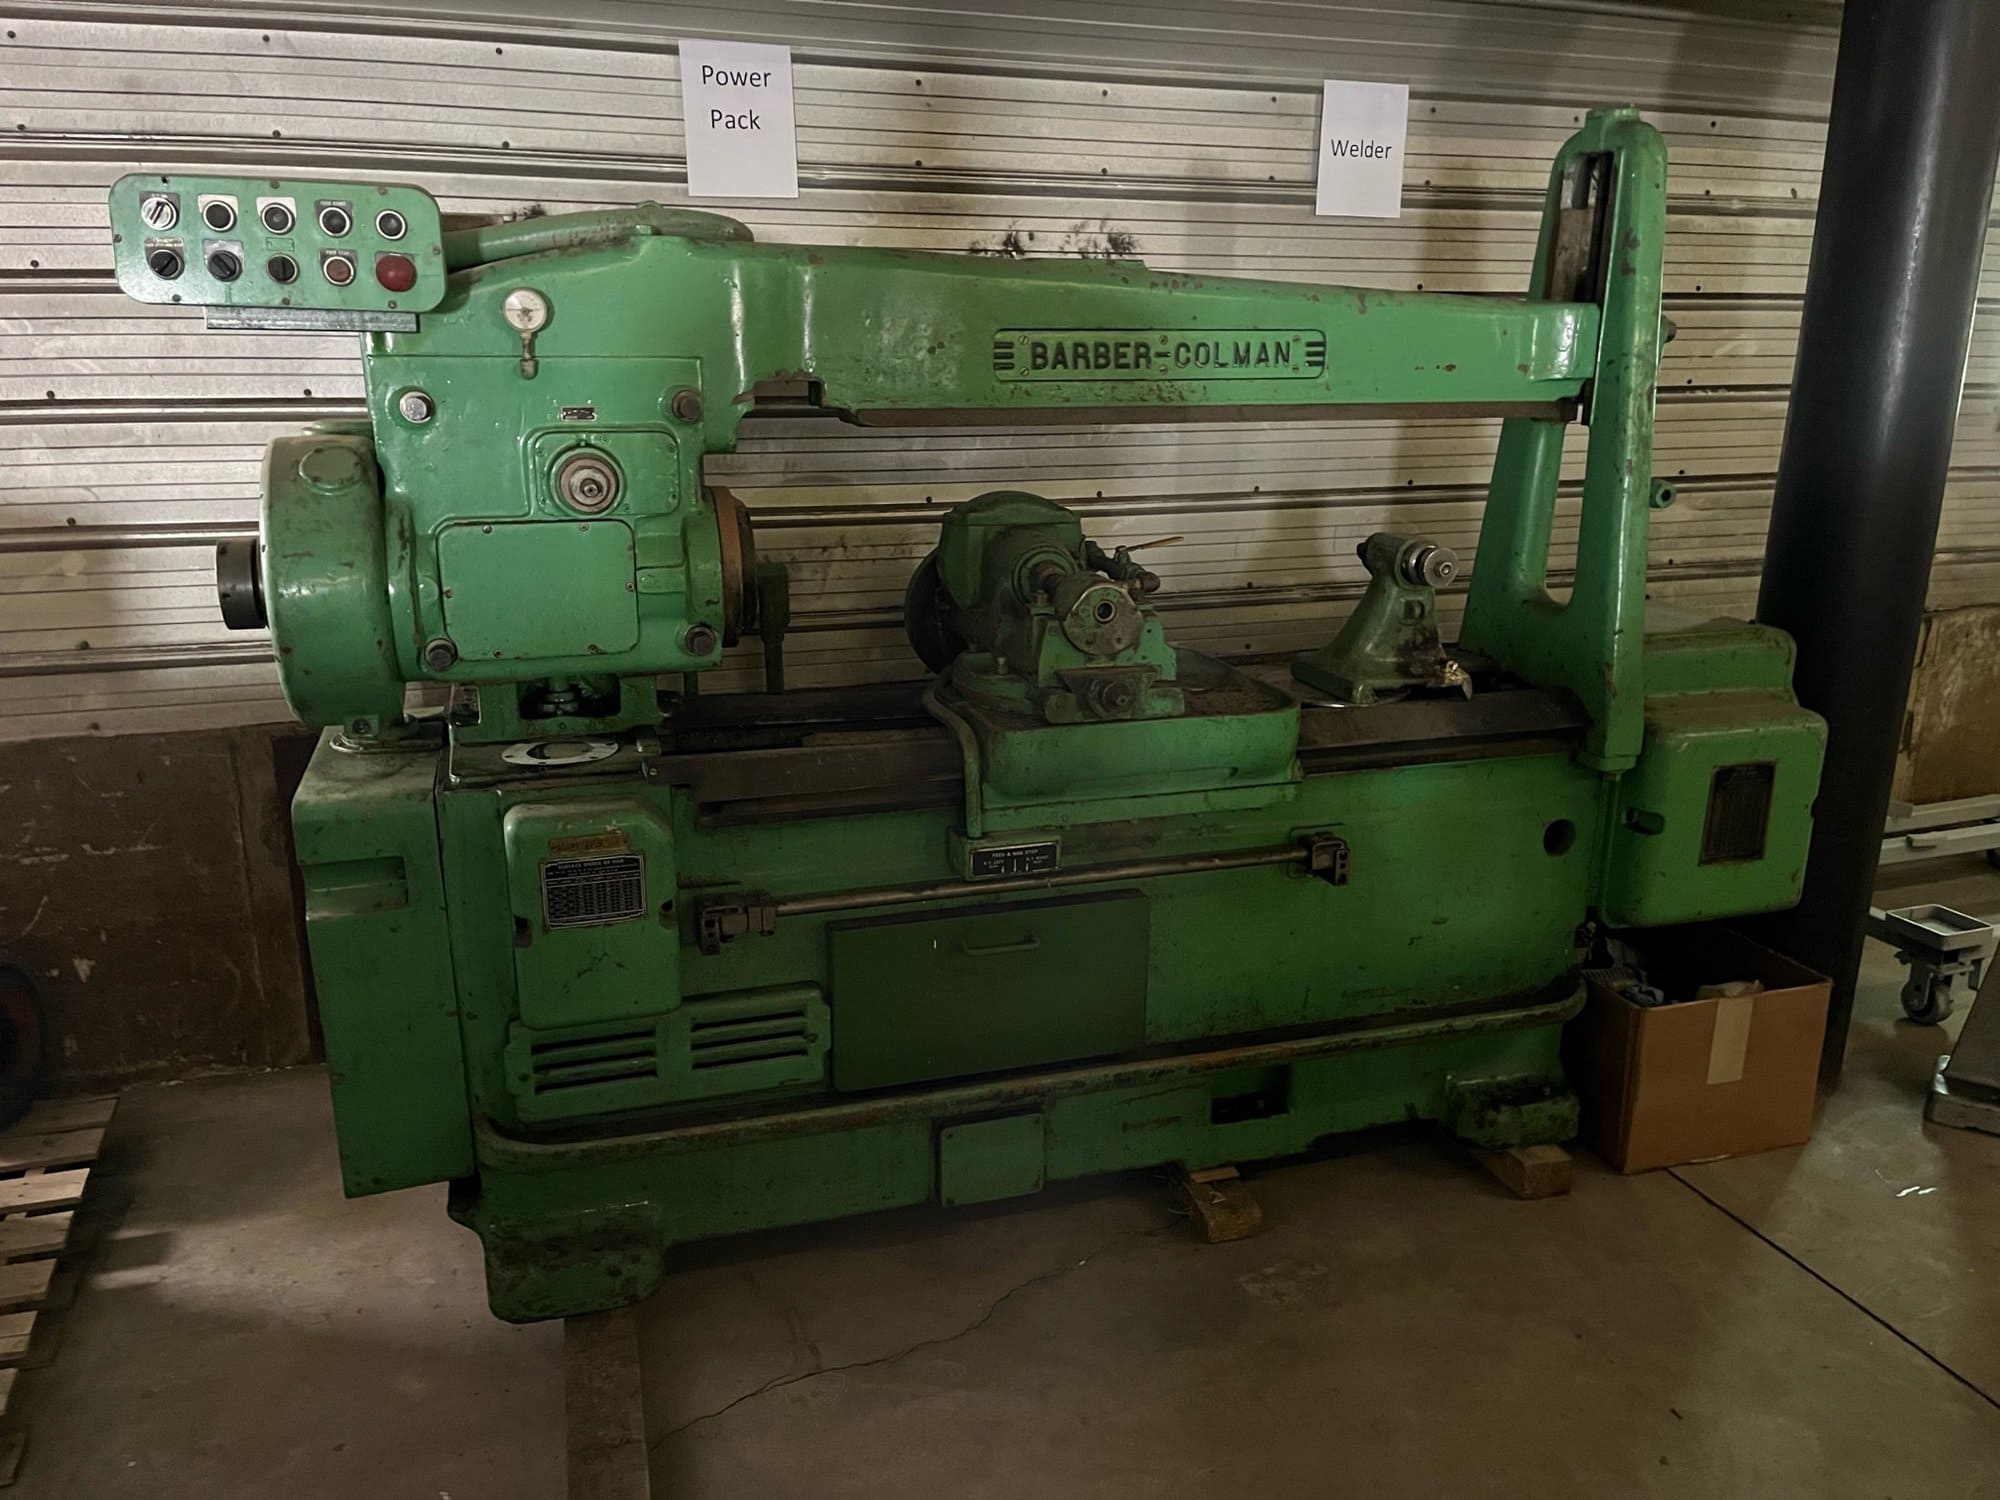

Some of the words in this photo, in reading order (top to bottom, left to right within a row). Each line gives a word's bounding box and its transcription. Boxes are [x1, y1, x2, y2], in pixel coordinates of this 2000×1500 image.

[702, 65, 772, 88] Power
[711, 109, 761, 130] Pack
[1331, 138, 1393, 159] Welder
[1030, 340, 1291, 371] BARBER-COLMAN
